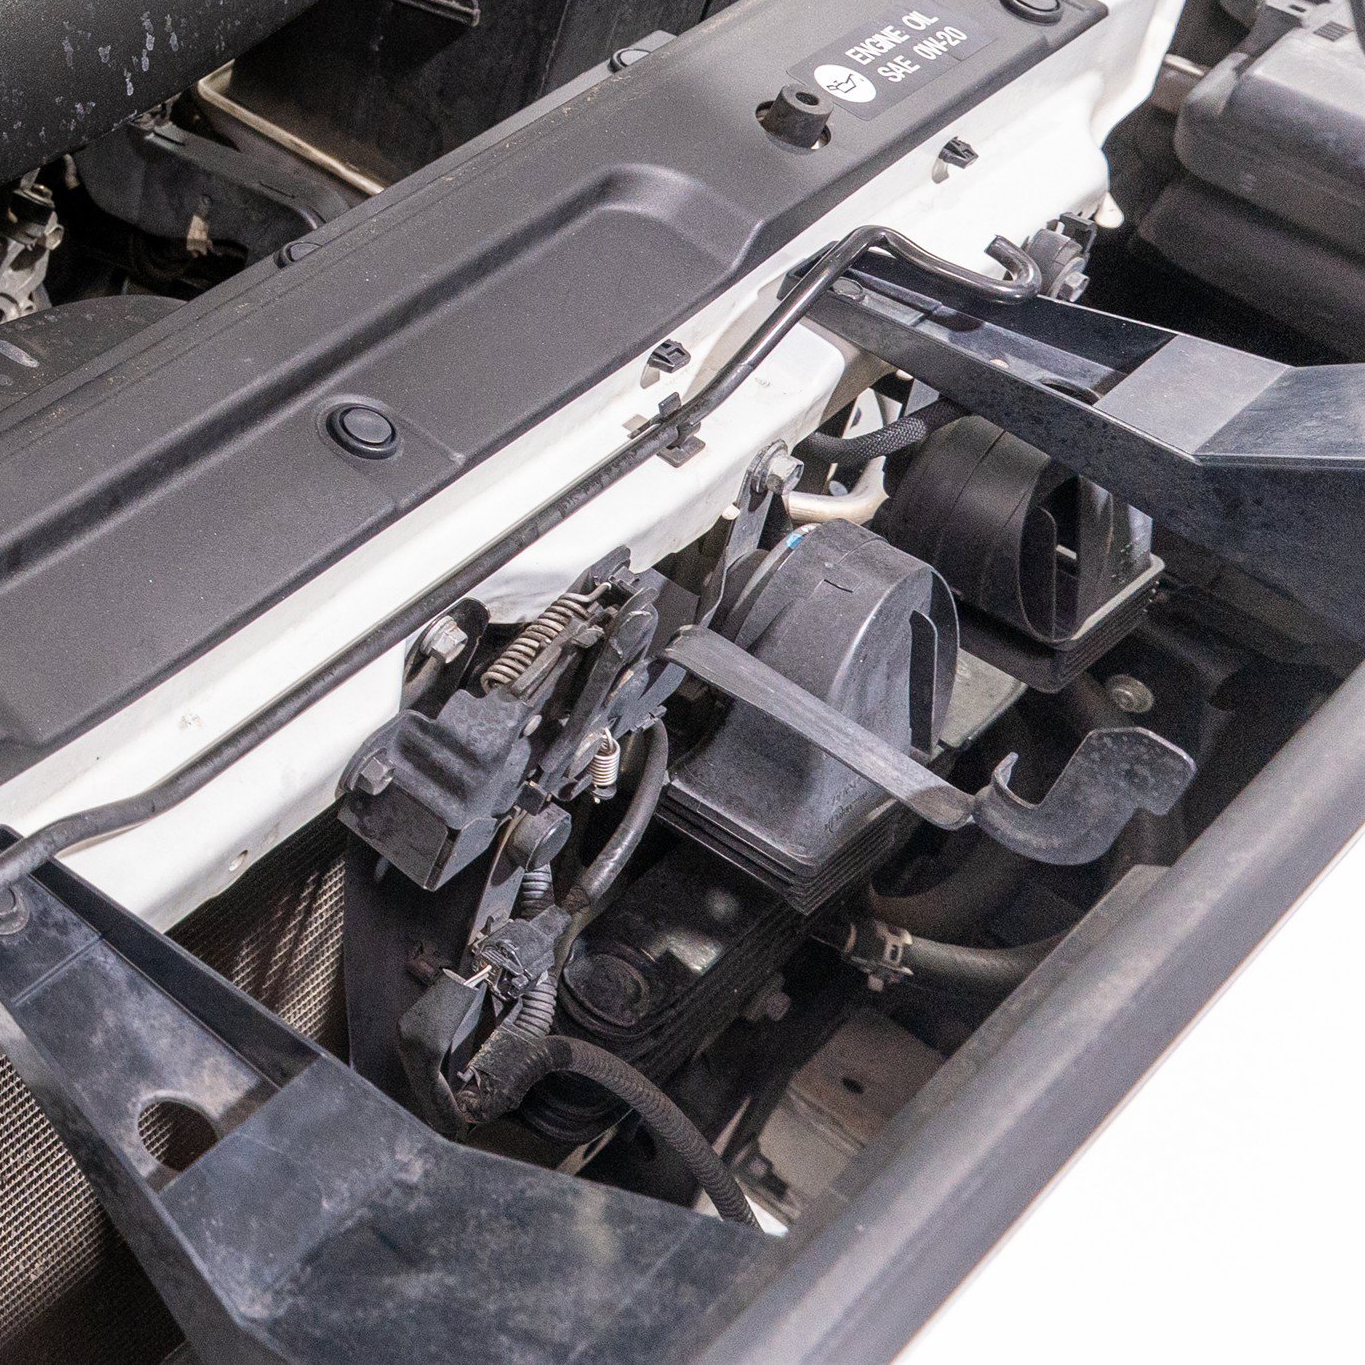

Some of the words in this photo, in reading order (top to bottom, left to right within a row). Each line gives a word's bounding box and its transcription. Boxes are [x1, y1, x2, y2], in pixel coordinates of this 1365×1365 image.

[844, 25, 910, 65] ENGINE
[902, 10, 940, 31] OIL
[877, 55, 921, 83] SAE
[913, 26, 968, 61] 0W-20
